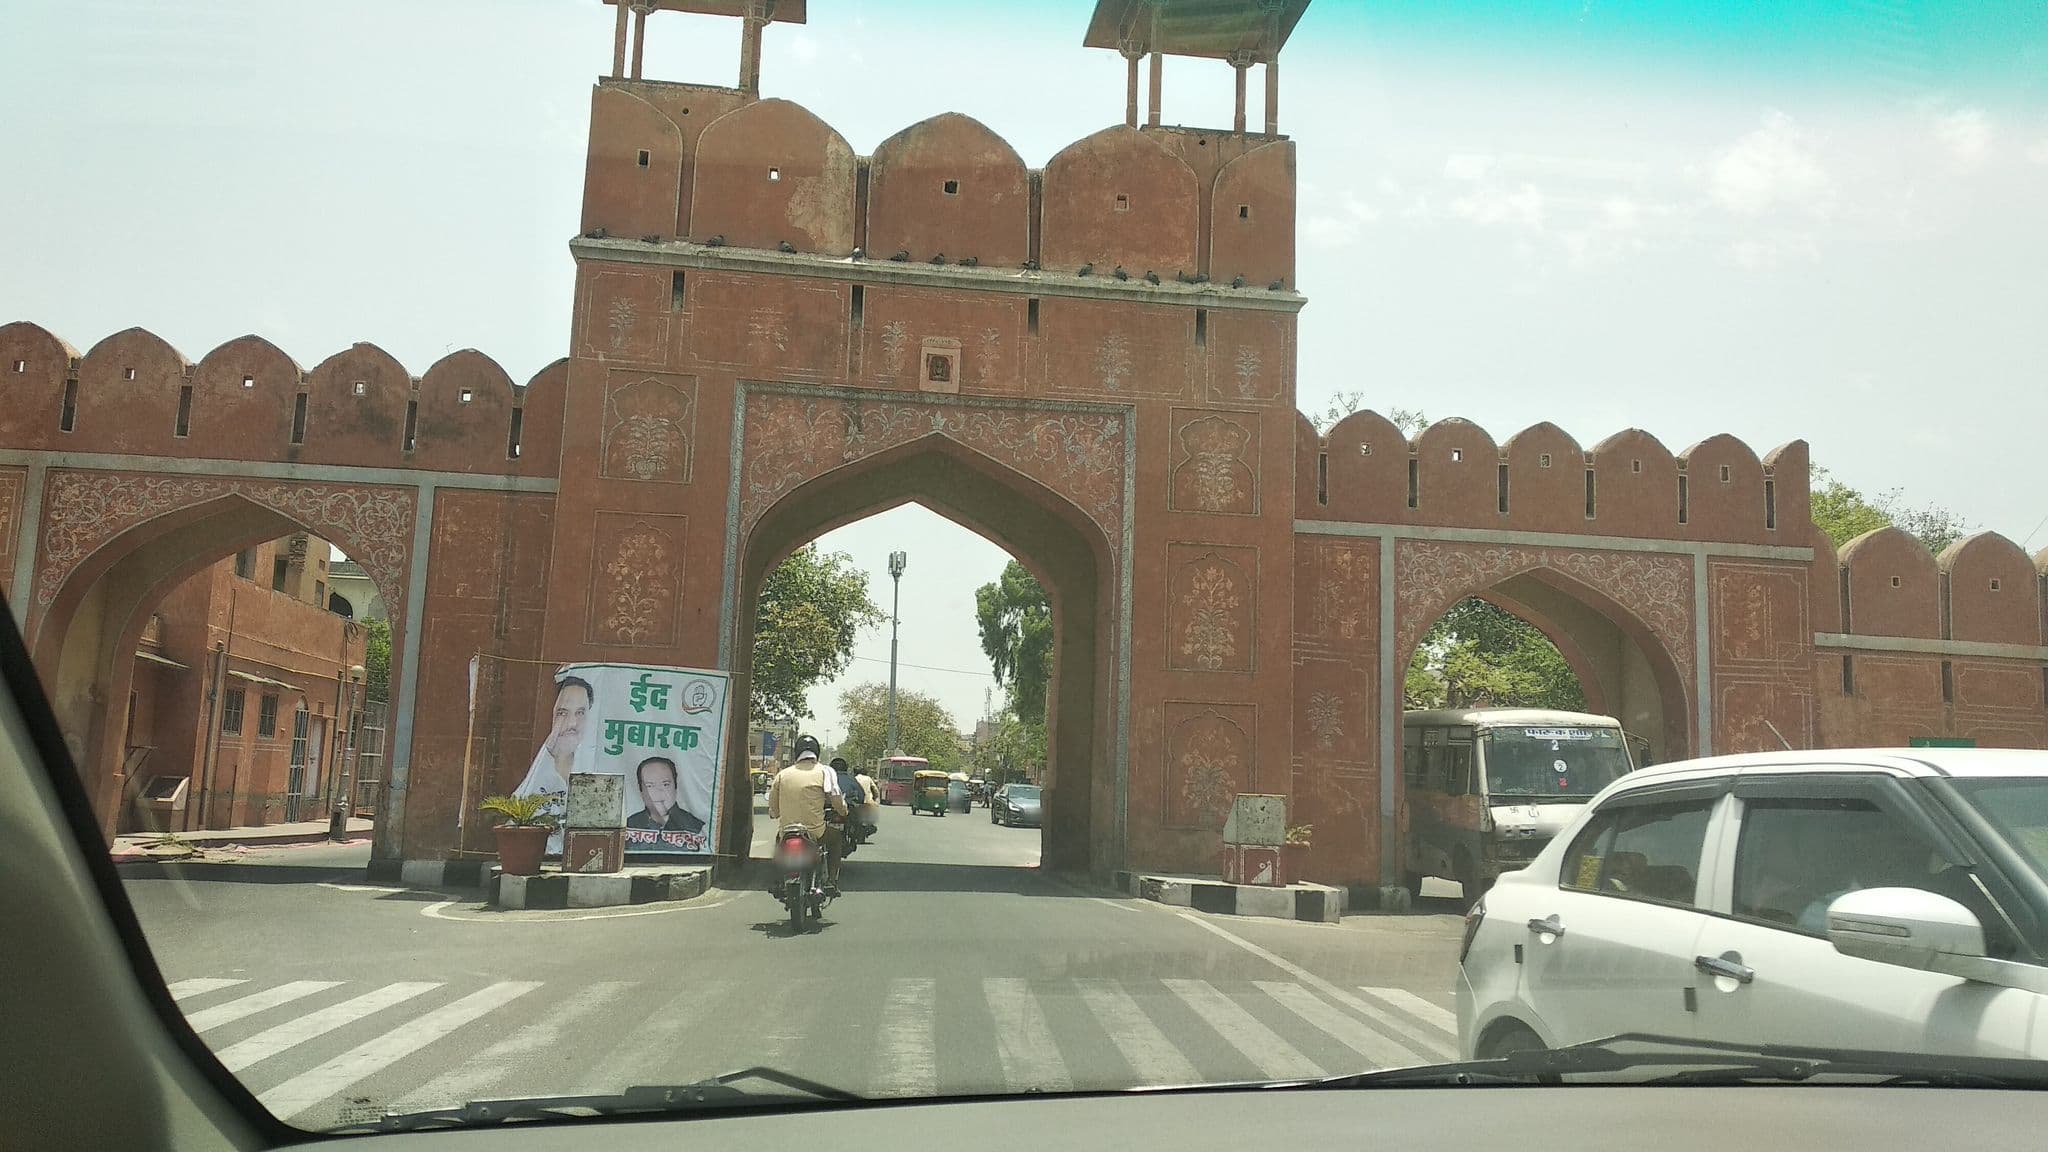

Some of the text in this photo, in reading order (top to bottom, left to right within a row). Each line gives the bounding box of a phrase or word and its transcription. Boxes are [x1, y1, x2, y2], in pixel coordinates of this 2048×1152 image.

[629, 673, 672, 713] ईद
[604, 719, 701, 756] मुबारक
[1551, 739, 1560, 751] 2
